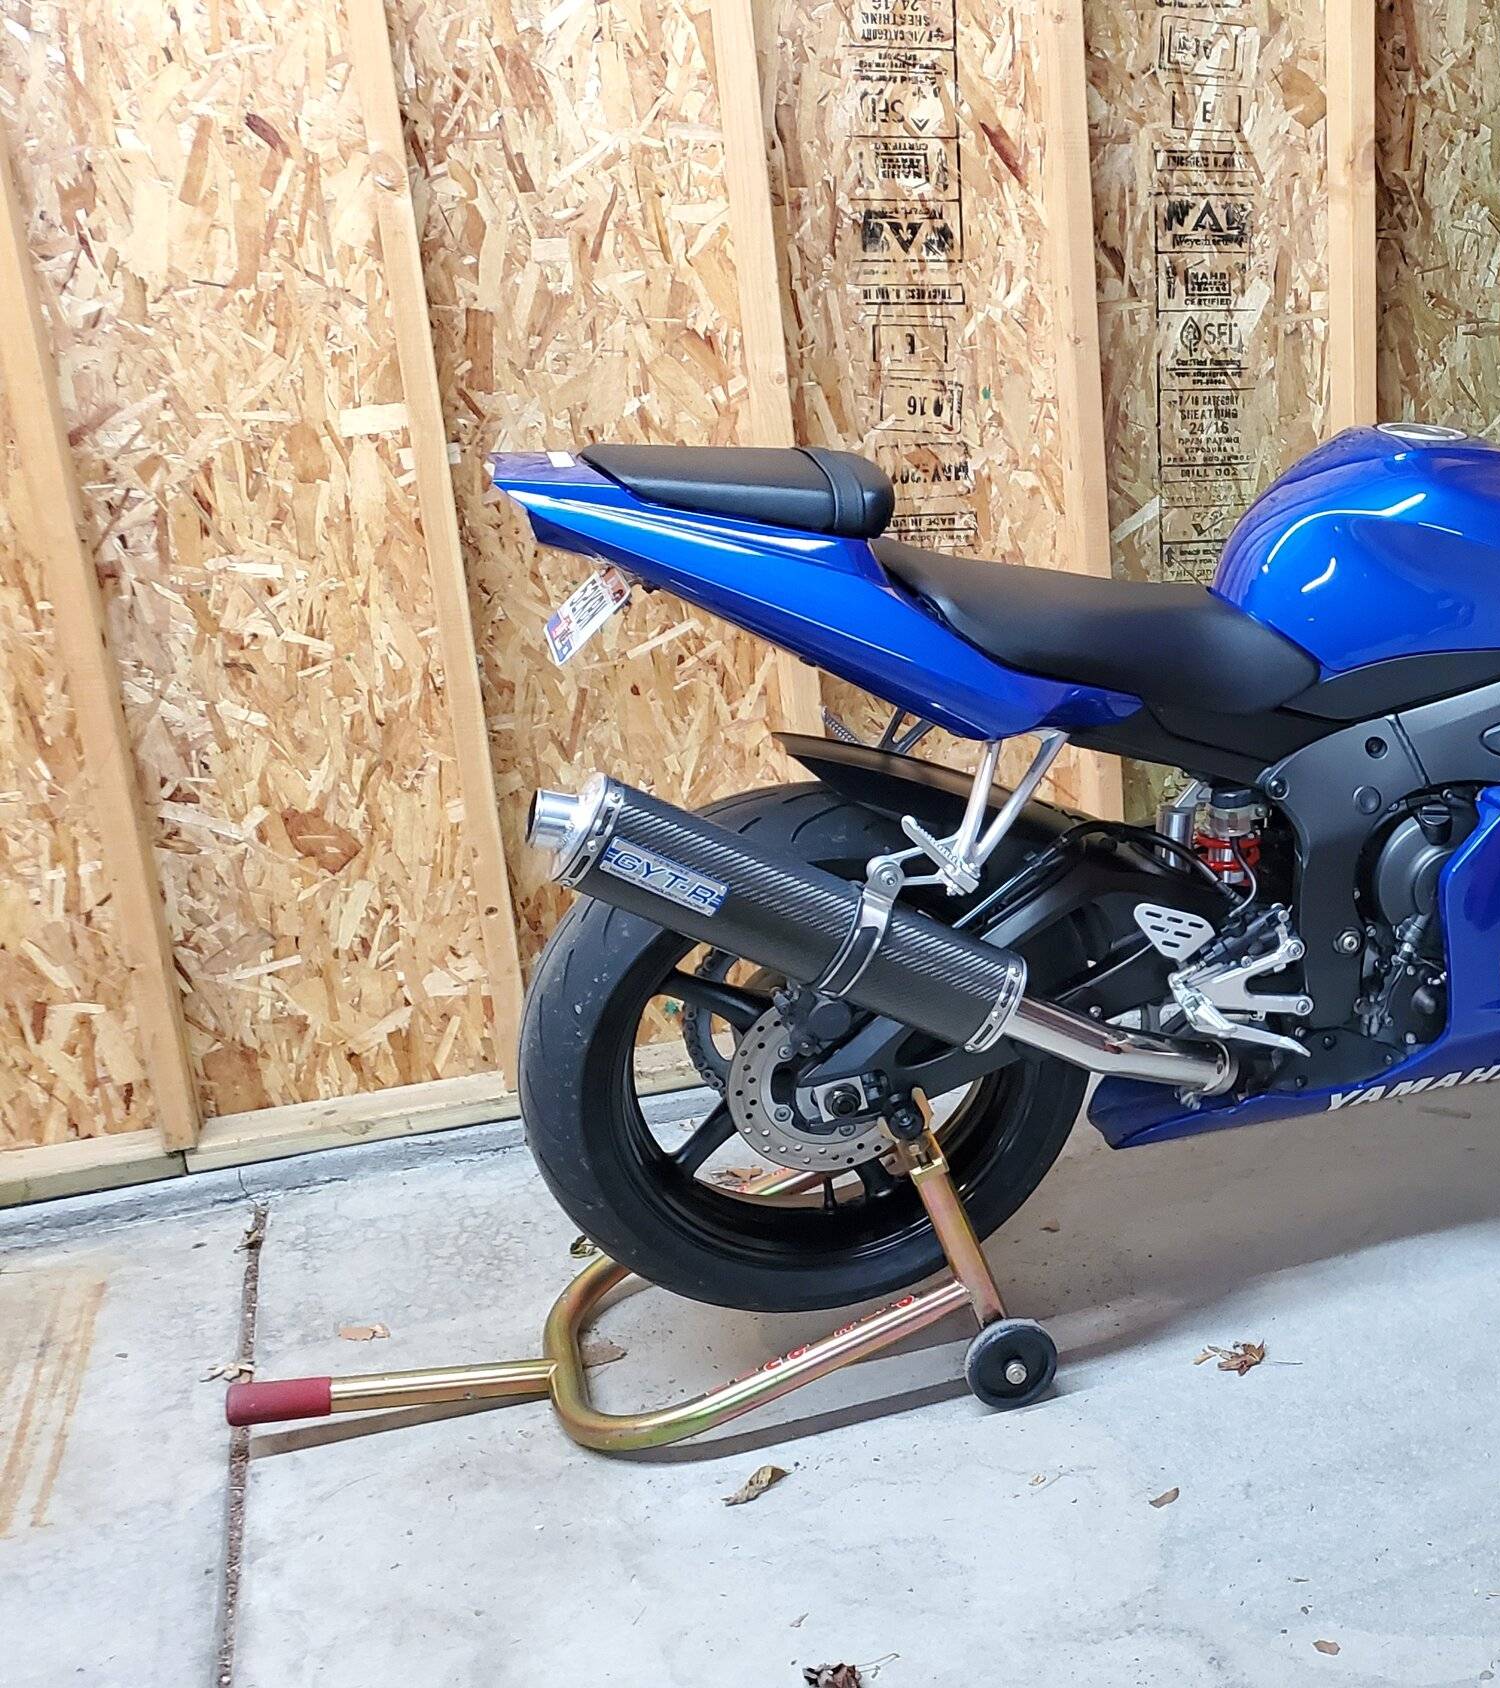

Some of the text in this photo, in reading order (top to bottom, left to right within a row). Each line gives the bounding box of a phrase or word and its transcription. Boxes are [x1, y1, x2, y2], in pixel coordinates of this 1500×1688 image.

[1184, 298, 1232, 306] CERTIFIED
[1203, 322, 1233, 346] SFI
[1202, 396, 1239, 406] CATEGORY
[1181, 409, 1238, 420] SHEATHING
[1189, 422, 1229, 434] 24/16
[1181, 469, 1210, 477] MILL
[926, 517, 955, 526] MADE
